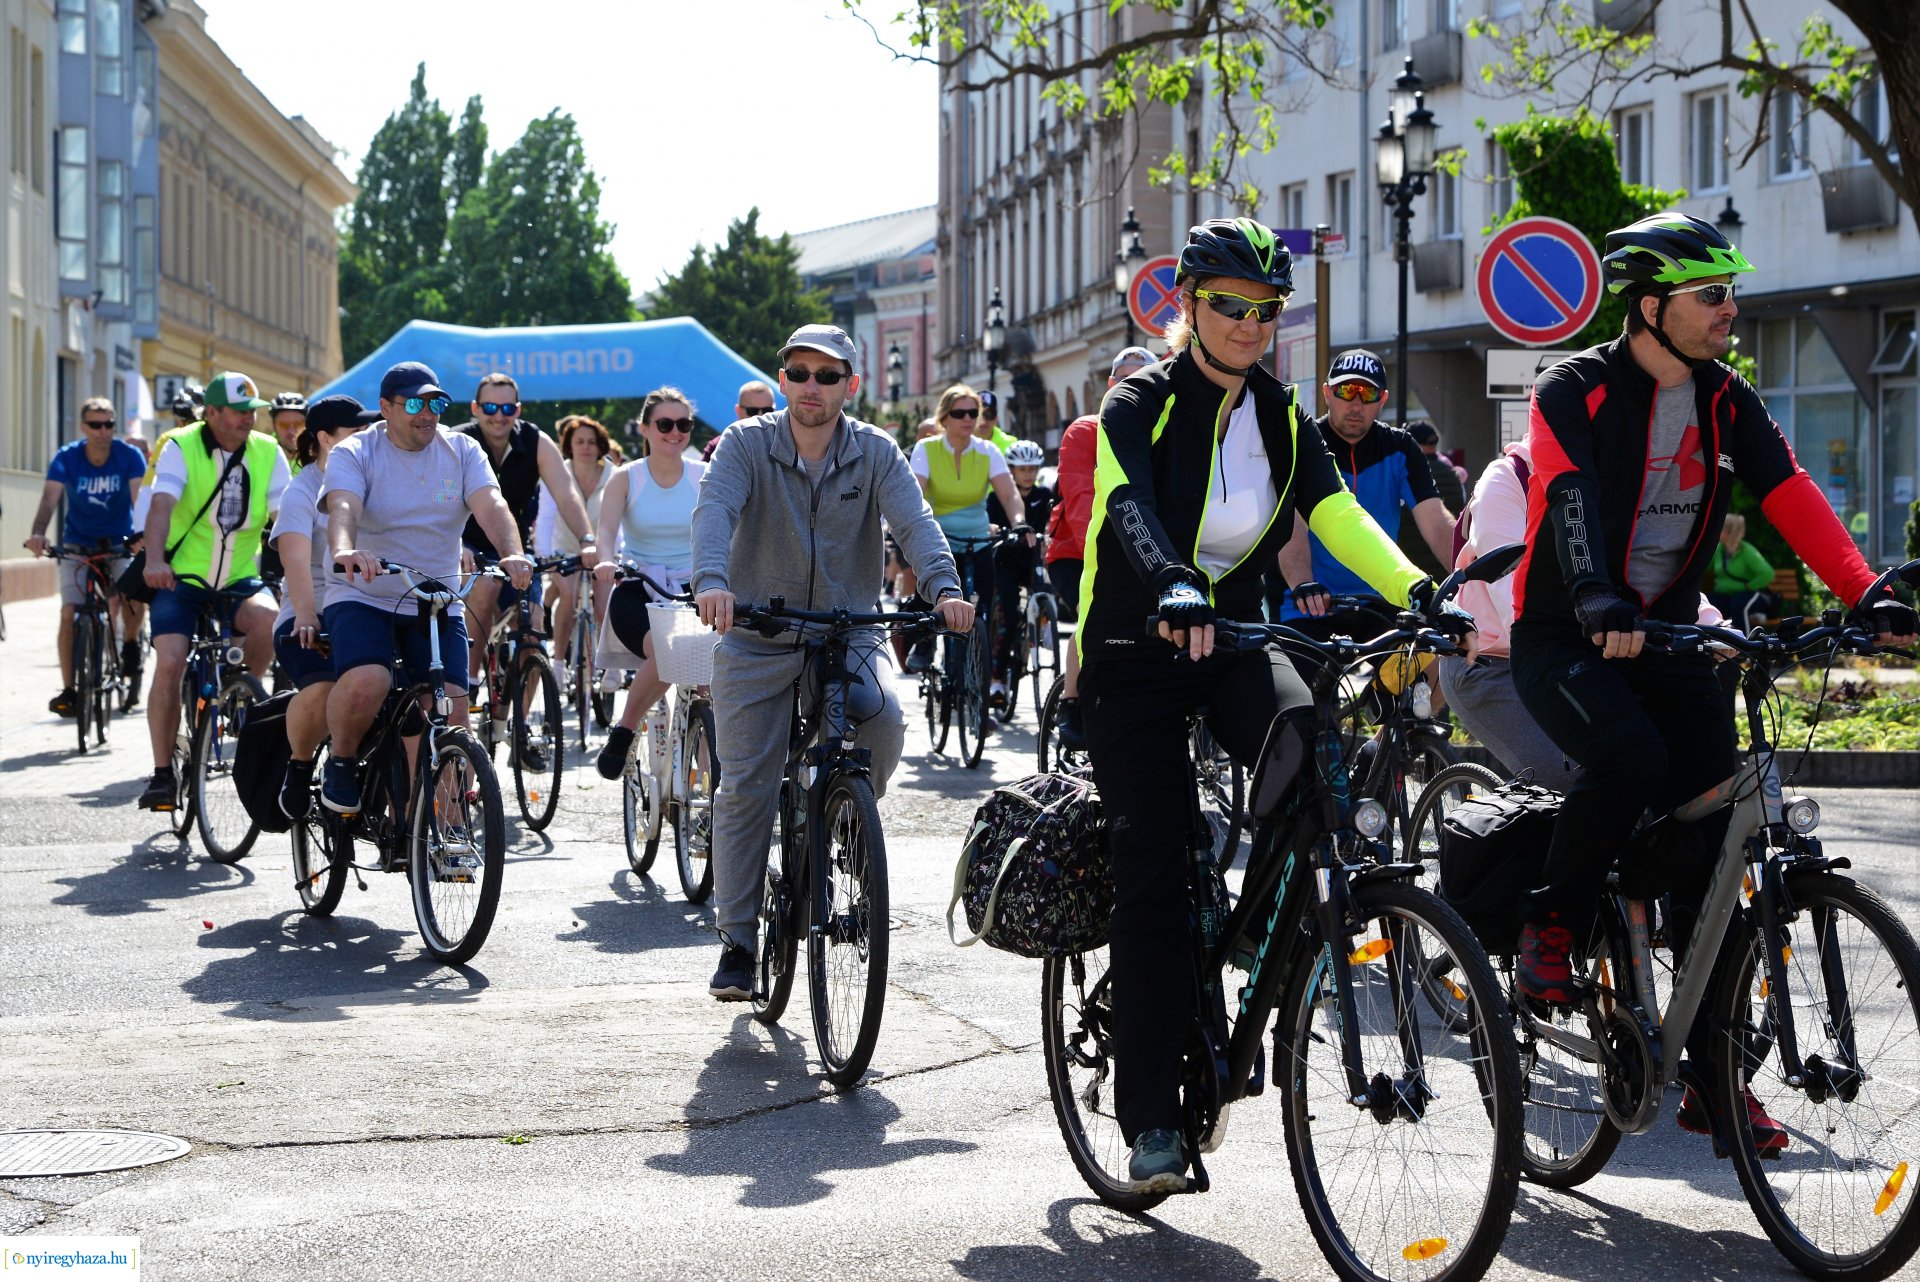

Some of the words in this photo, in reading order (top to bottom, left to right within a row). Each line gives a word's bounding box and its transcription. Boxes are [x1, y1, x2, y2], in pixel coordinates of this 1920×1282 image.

[1610, 260, 1627, 270] uvex
[465, 347, 634, 377] SHIMANO
[77, 474, 120, 494] PUMA
[840, 491, 859, 501] PUMA
[1645, 502, 1702, 516] ARMO
[1115, 500, 1167, 571] FORCE
[1560, 487, 1594, 575] FORCE
